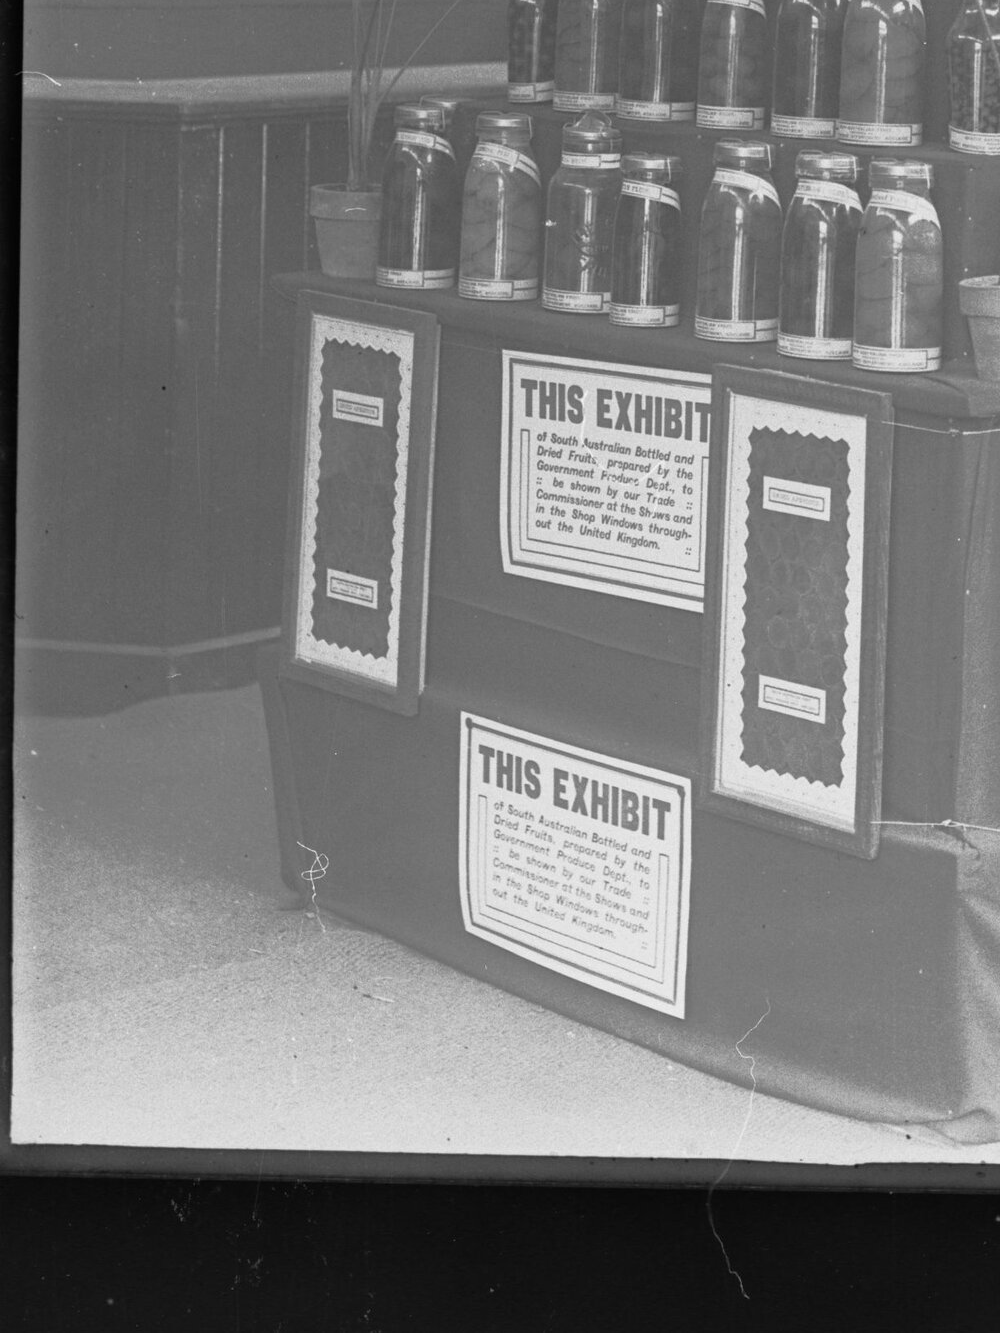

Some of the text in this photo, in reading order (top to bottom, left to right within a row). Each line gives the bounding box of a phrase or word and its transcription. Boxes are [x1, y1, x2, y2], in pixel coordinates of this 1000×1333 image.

[520, 378, 711, 443] THIS EXHIBIT
[536, 431, 695, 465] of South Australian Bottled and
[537, 445, 563, 459] Dried
[607, 459, 651, 473] prepared
[657, 465, 670, 479] by
[677, 468, 693, 480] the
[537, 459, 595, 479] Government
[682, 484, 693, 495] to
[552, 477, 675, 507] be shown by our Trade
[535, 503, 692, 541] in the Shop Windows through-
[536, 488, 604, 509] Commissioner
[607, 502, 618, 512] at
[620, 503, 636, 515] the
[673, 515, 693, 525] and
[535, 519, 660, 550] out the United Kingdom.
[478, 744, 671, 841] THIS EXHIBIT
[493, 801, 652, 860] of South Australian Bottled and
[493, 814, 519, 831] Dried
[563, 840, 608, 861] prepared
[614, 855, 626, 869] by
[633, 861, 650, 875] the
[493, 829, 550, 856] Government
[556, 849, 595, 872] Produce
[640, 878, 650, 890] to
[509, 848, 631, 899] be shown by our Trade
[492, 874, 501, 883] in
[506, 877, 522, 890] the
[527, 883, 550, 901] Shop
[556, 895, 598, 918] Windows
[492, 888, 508, 900] out
[513, 894, 528, 908] the
[535, 902, 566, 921] United
[493, 857, 649, 920] Commissioner at the Shows and
